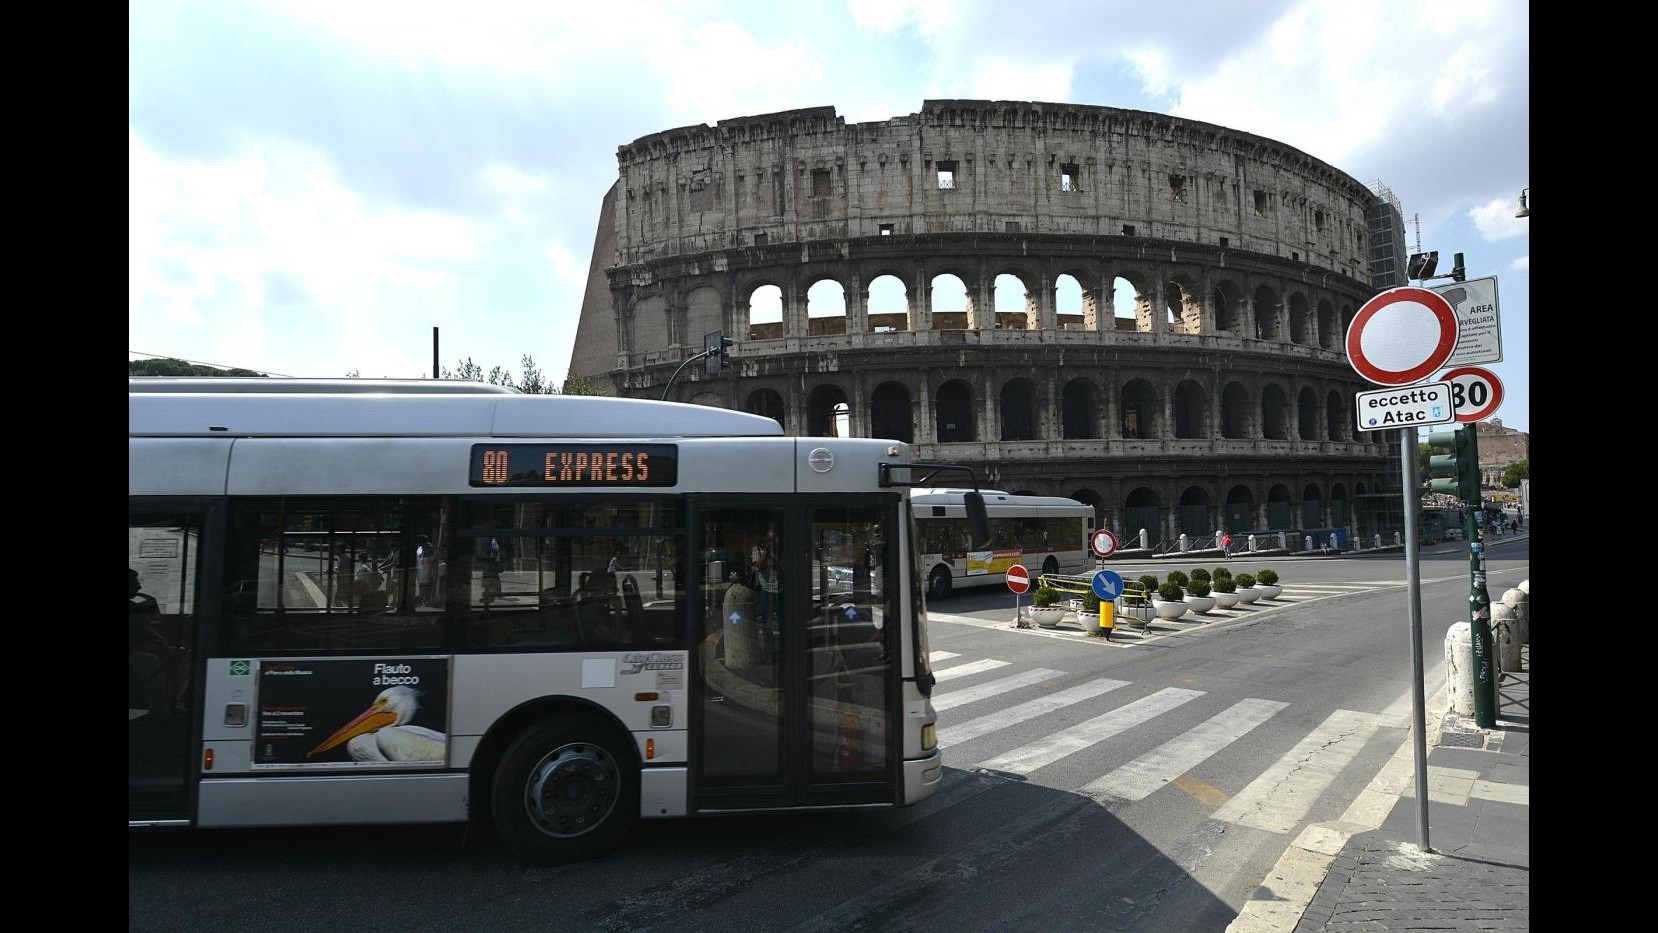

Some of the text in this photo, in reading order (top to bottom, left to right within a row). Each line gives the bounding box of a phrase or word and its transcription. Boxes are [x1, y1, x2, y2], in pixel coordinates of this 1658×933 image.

[1470, 304, 1493, 314] AREA
[1368, 389, 1439, 408] eccetto
[1453, 381, 1488, 408] 30
[1382, 410, 1426, 424] Atac
[482, 450, 649, 483] 80 EXPRESS
[373, 663, 412, 674] Flauto
[373, 675, 419, 685] a becco
